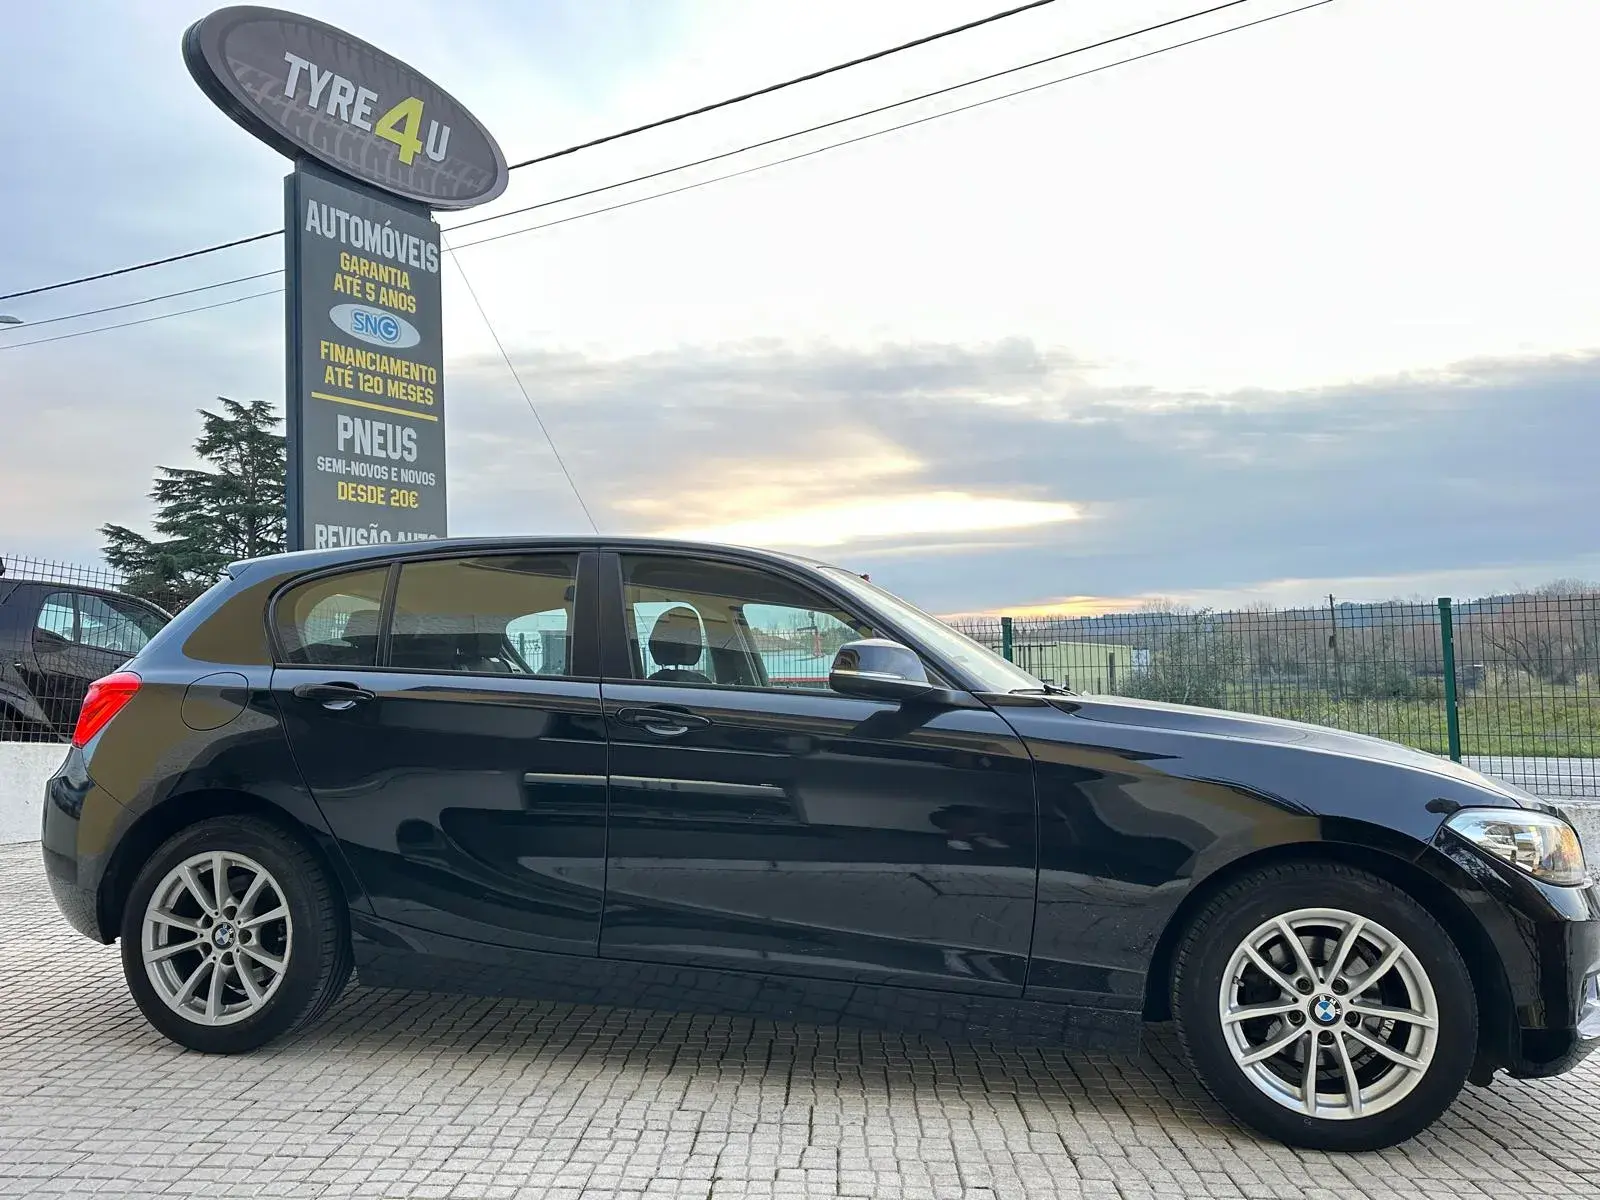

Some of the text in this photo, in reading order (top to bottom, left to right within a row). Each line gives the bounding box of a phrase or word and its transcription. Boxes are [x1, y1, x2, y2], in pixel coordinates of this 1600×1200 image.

[305, 199, 439, 274] AUTOMÓVEIS
[340, 251, 410, 290] GARANTIA
[333, 272, 417, 314] ATÉ 5 ANOS
[352, 310, 400, 343] SNG
[320, 340, 437, 385] FINANCIAMENTO
[324, 365, 434, 406] ATÉ 120 MESES
[337, 414, 417, 462] PNEUS
[317, 456, 436, 486] SEMI-NOVOS E NOVOS
[337, 481, 419, 509] DESDE 20€
